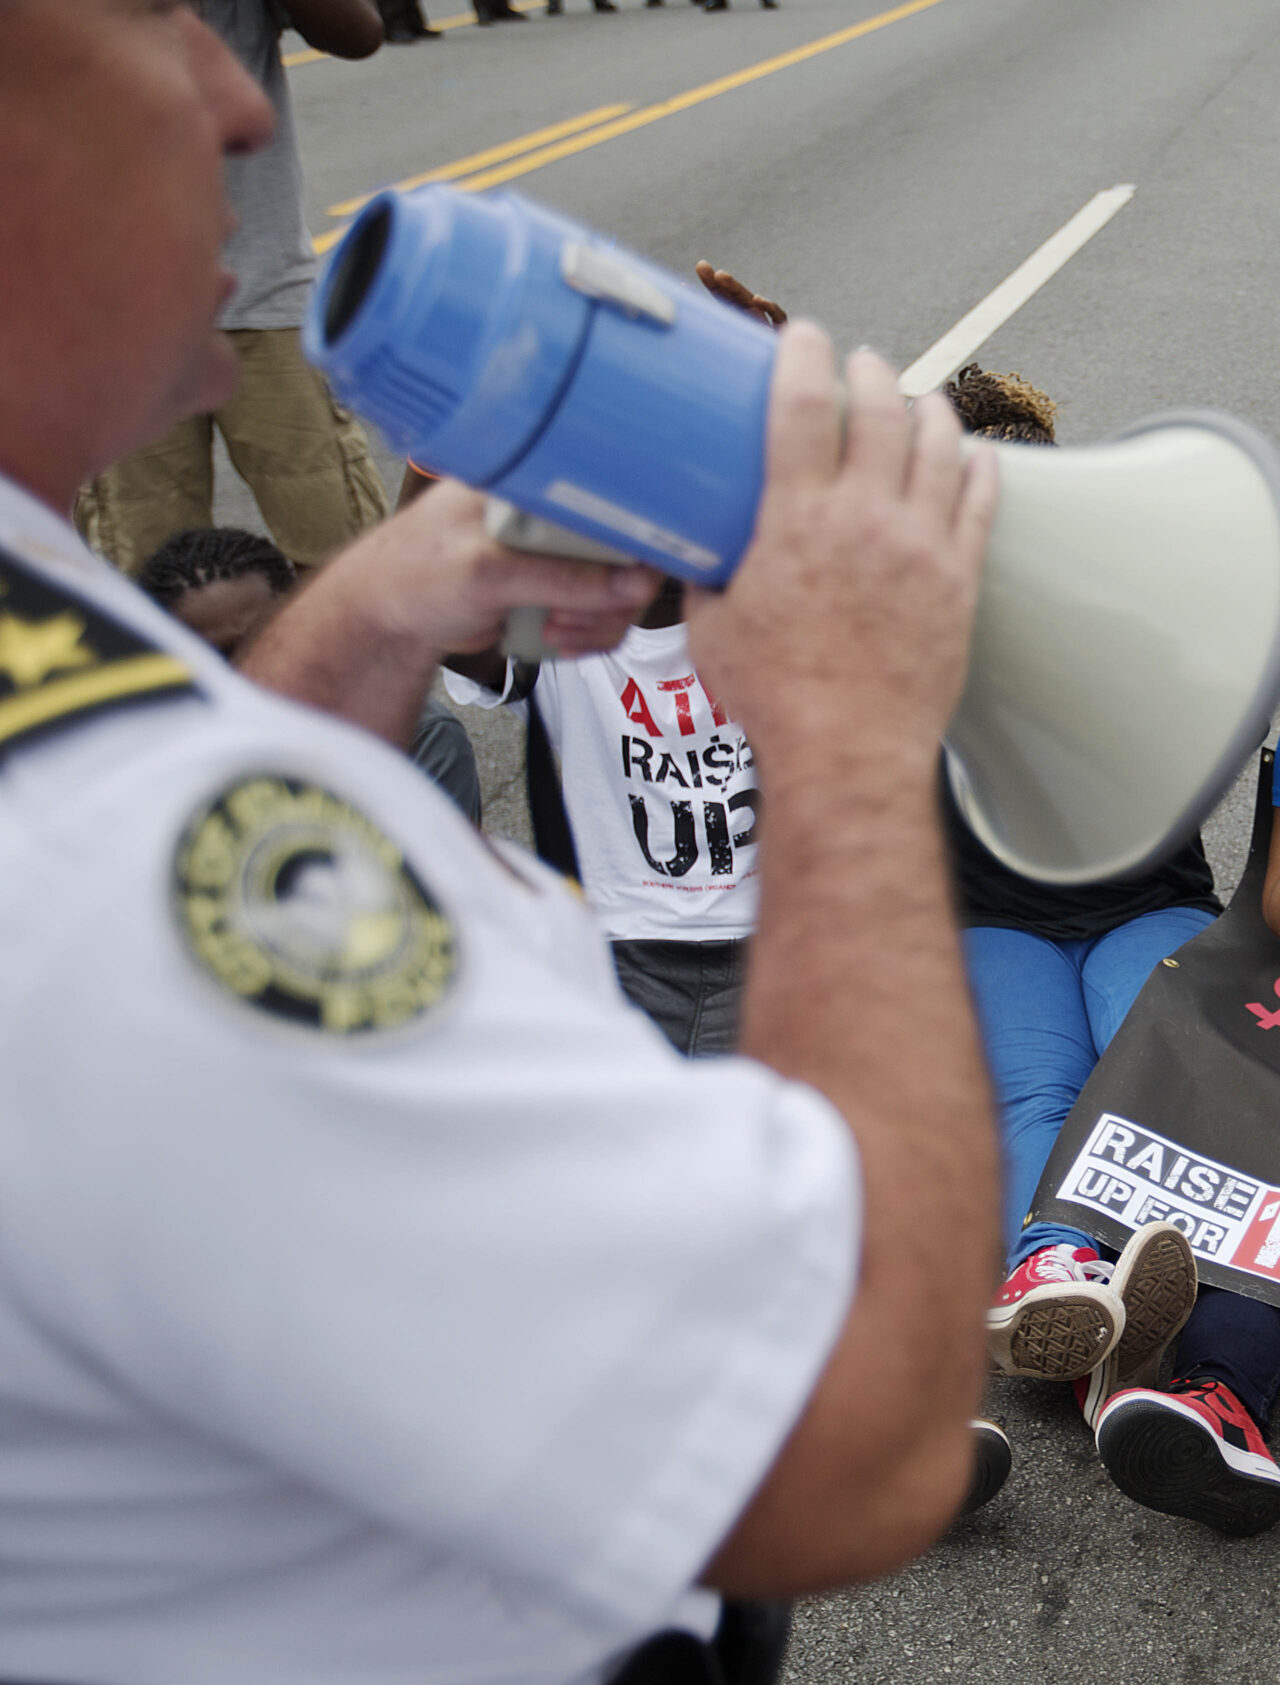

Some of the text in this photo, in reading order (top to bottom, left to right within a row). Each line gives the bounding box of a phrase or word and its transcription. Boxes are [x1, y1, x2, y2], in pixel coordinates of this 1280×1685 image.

[628, 788, 765, 878] UP
[1077, 1168, 1226, 1254] UP FOR
[1092, 1121, 1257, 1220] RAISE
